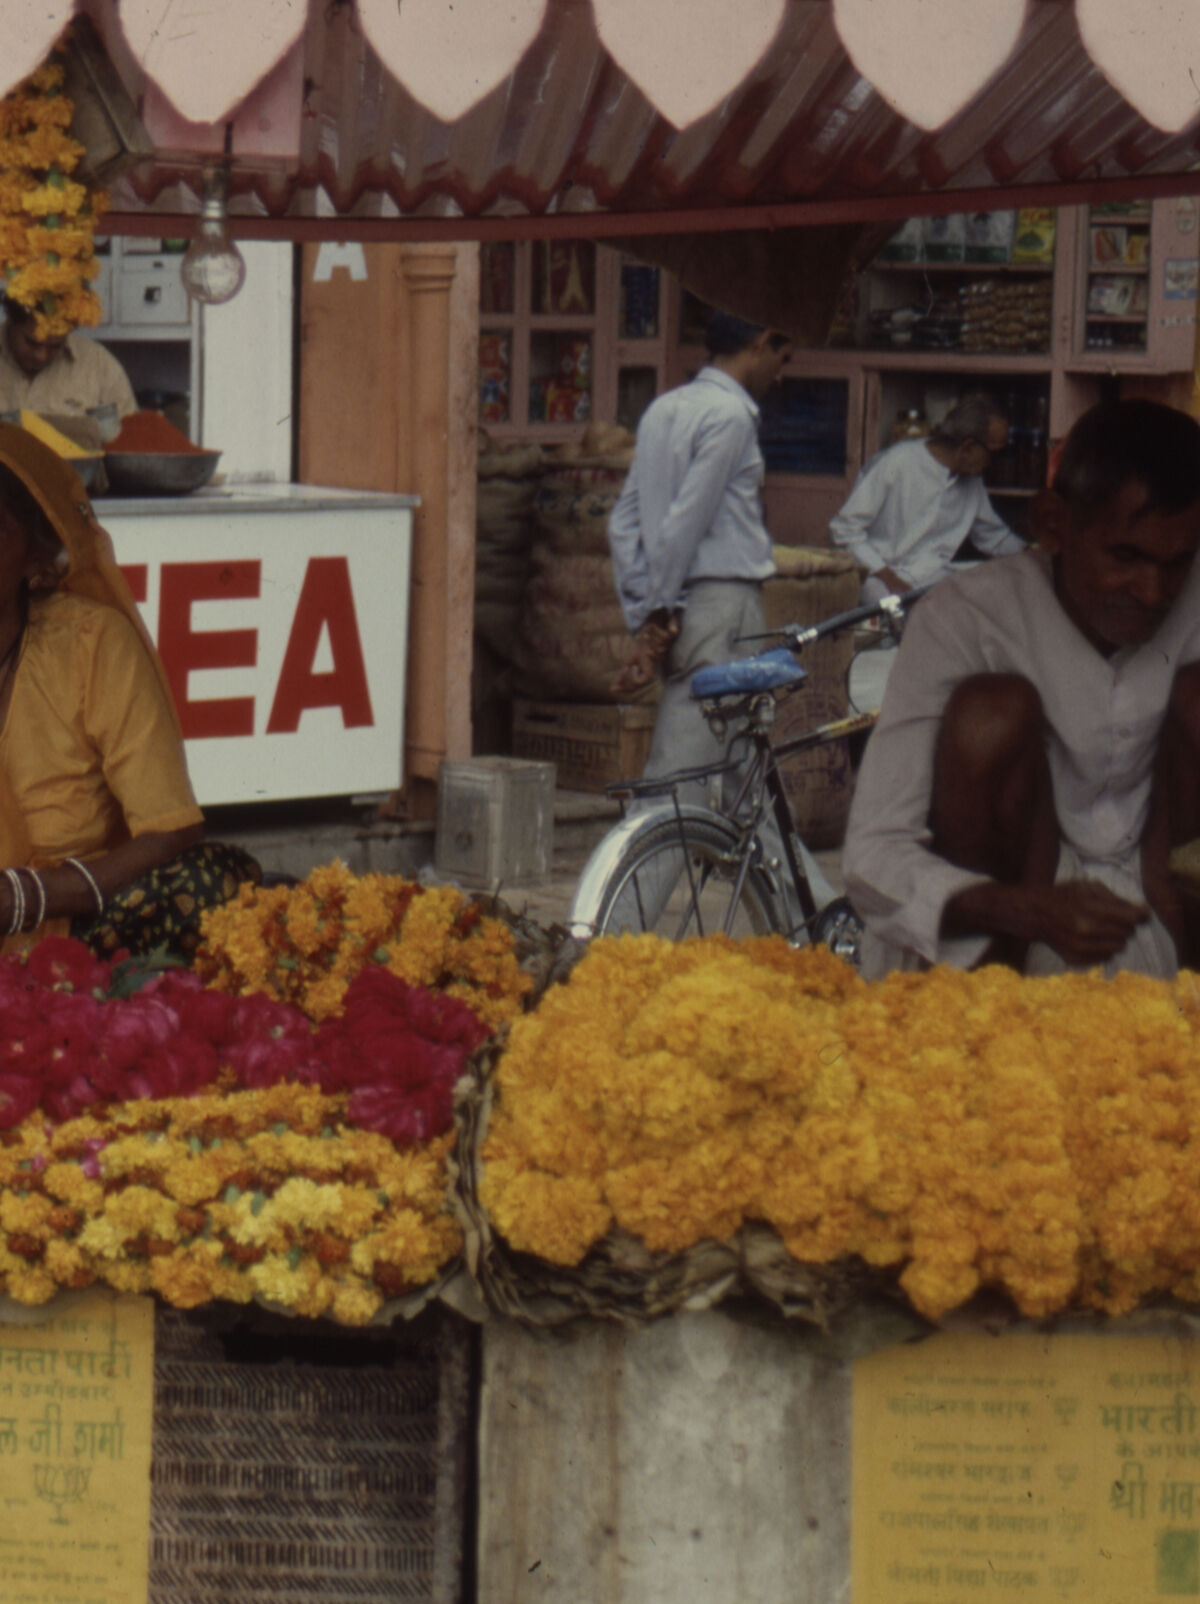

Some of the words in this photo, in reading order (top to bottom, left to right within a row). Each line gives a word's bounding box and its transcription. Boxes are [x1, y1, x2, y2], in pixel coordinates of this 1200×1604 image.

[115, 555, 375, 740] EA
[64, 1338, 132, 1380] पार्टी
[28, 1403, 63, 1457] जी
